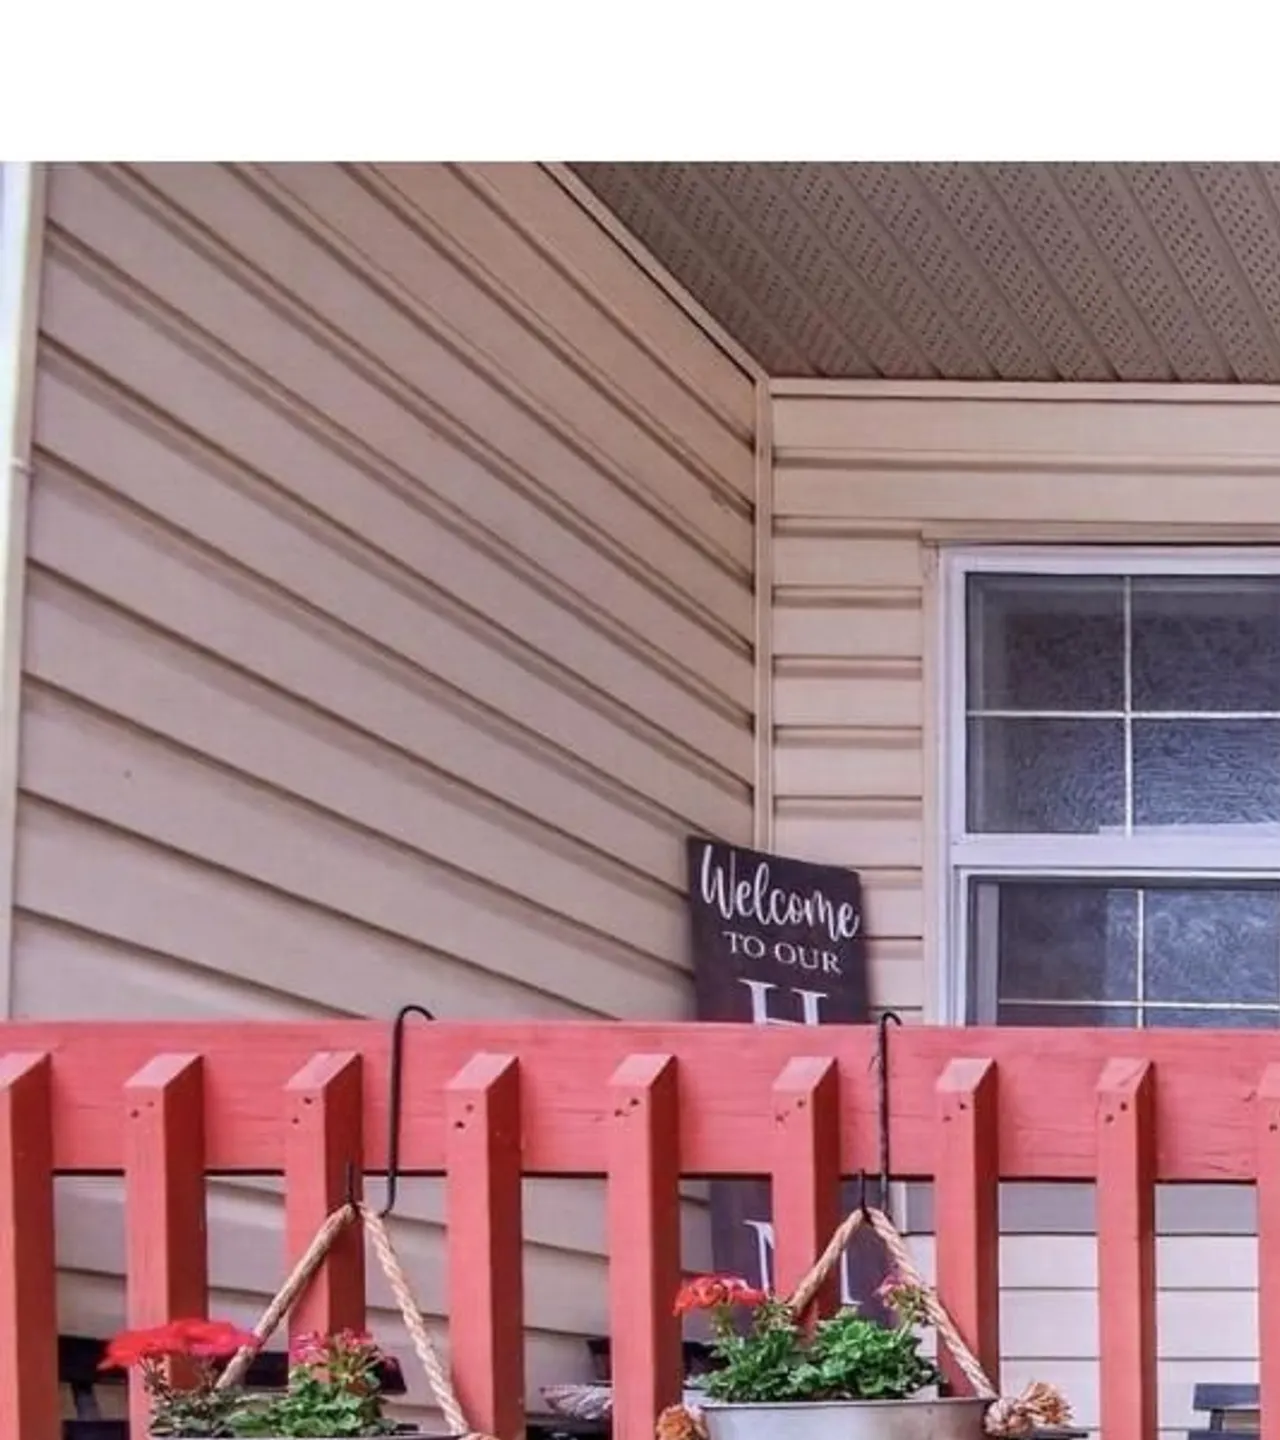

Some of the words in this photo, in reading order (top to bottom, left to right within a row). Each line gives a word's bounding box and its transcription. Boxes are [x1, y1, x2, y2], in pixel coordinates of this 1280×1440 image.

[701, 844, 860, 942] Welcome
[722, 930, 766, 959] TO
[774, 942, 843, 975] OUR
